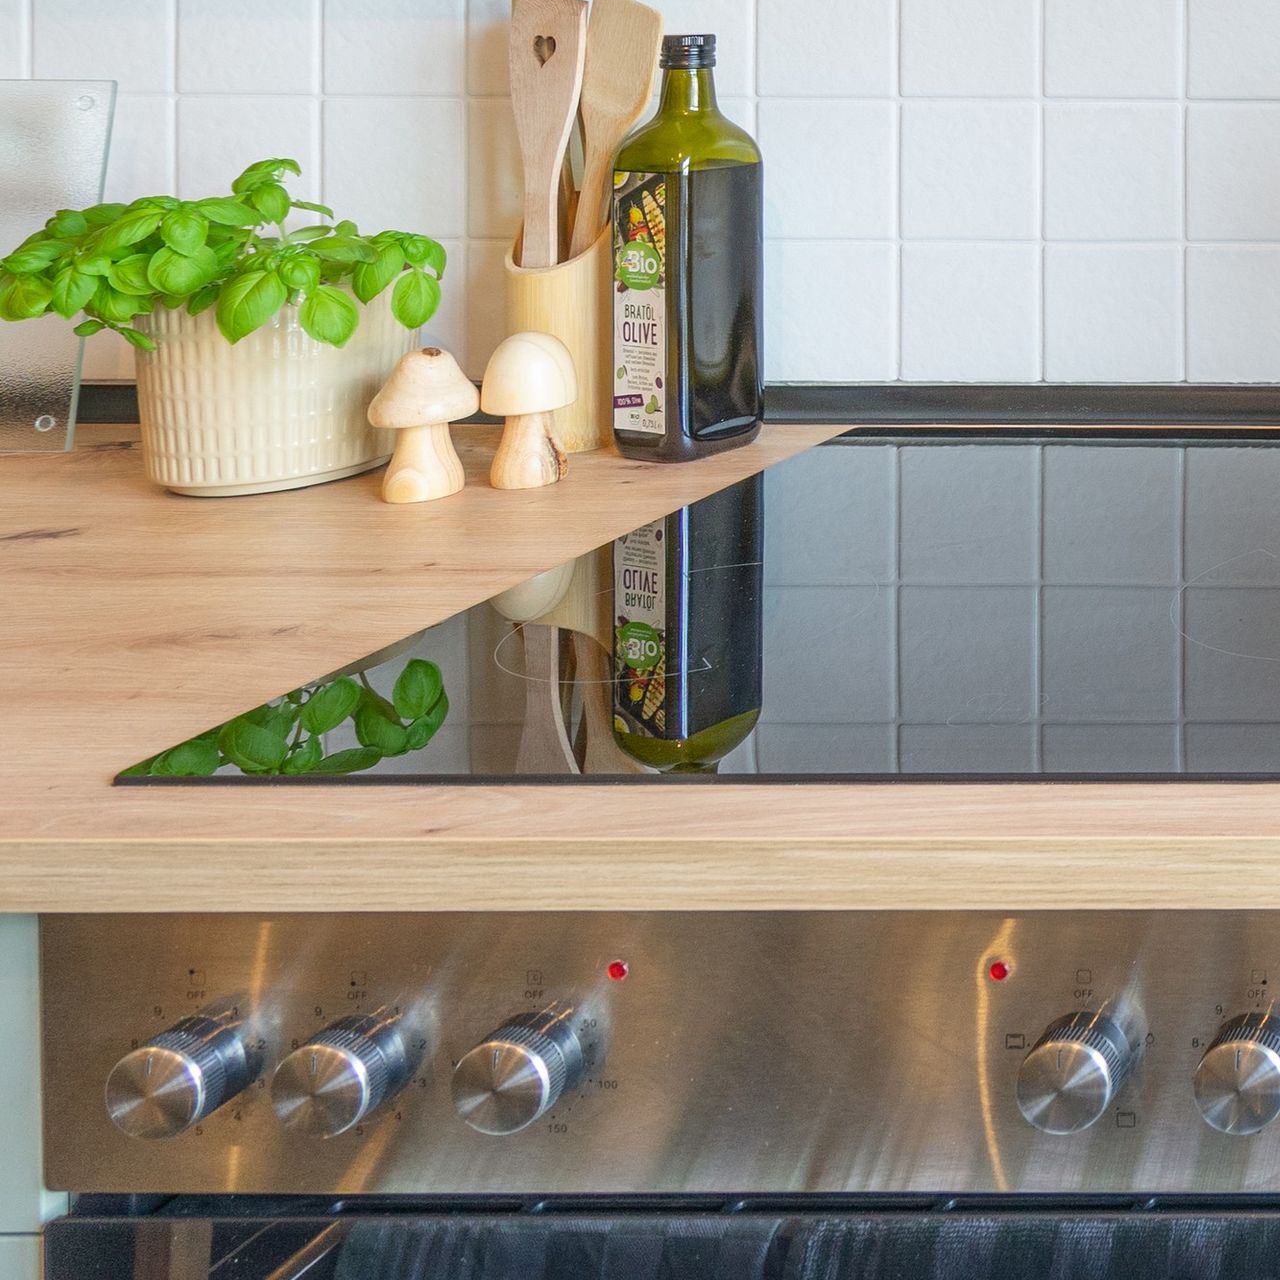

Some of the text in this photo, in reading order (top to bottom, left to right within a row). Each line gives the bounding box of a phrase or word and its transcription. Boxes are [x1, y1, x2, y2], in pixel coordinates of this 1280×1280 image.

[627, 250, 657, 274] Bio
[624, 303, 656, 321] BRATÖL
[623, 321, 658, 346] OLIVE
[187, 991, 206, 1000] OFF
[347, 991, 367, 1000] OFF
[524, 991, 544, 1000] OFF
[1074, 989, 1094, 999] OFF
[1247, 990, 1267, 999] OFF
[314, 1006, 322, 1016] 9
[1216, 1005, 1223, 1015] 9
[583, 1019, 597, 1029] 50
[258, 1040, 266, 1049] 2
[291, 1039, 299, 1049] 8
[419, 1039, 427, 1049] 2
[1192, 1038, 1199, 1048] 8
[419, 1079, 427, 1088] 3
[598, 1080, 618, 1089] 100
[548, 1124, 568, 1133] 150
